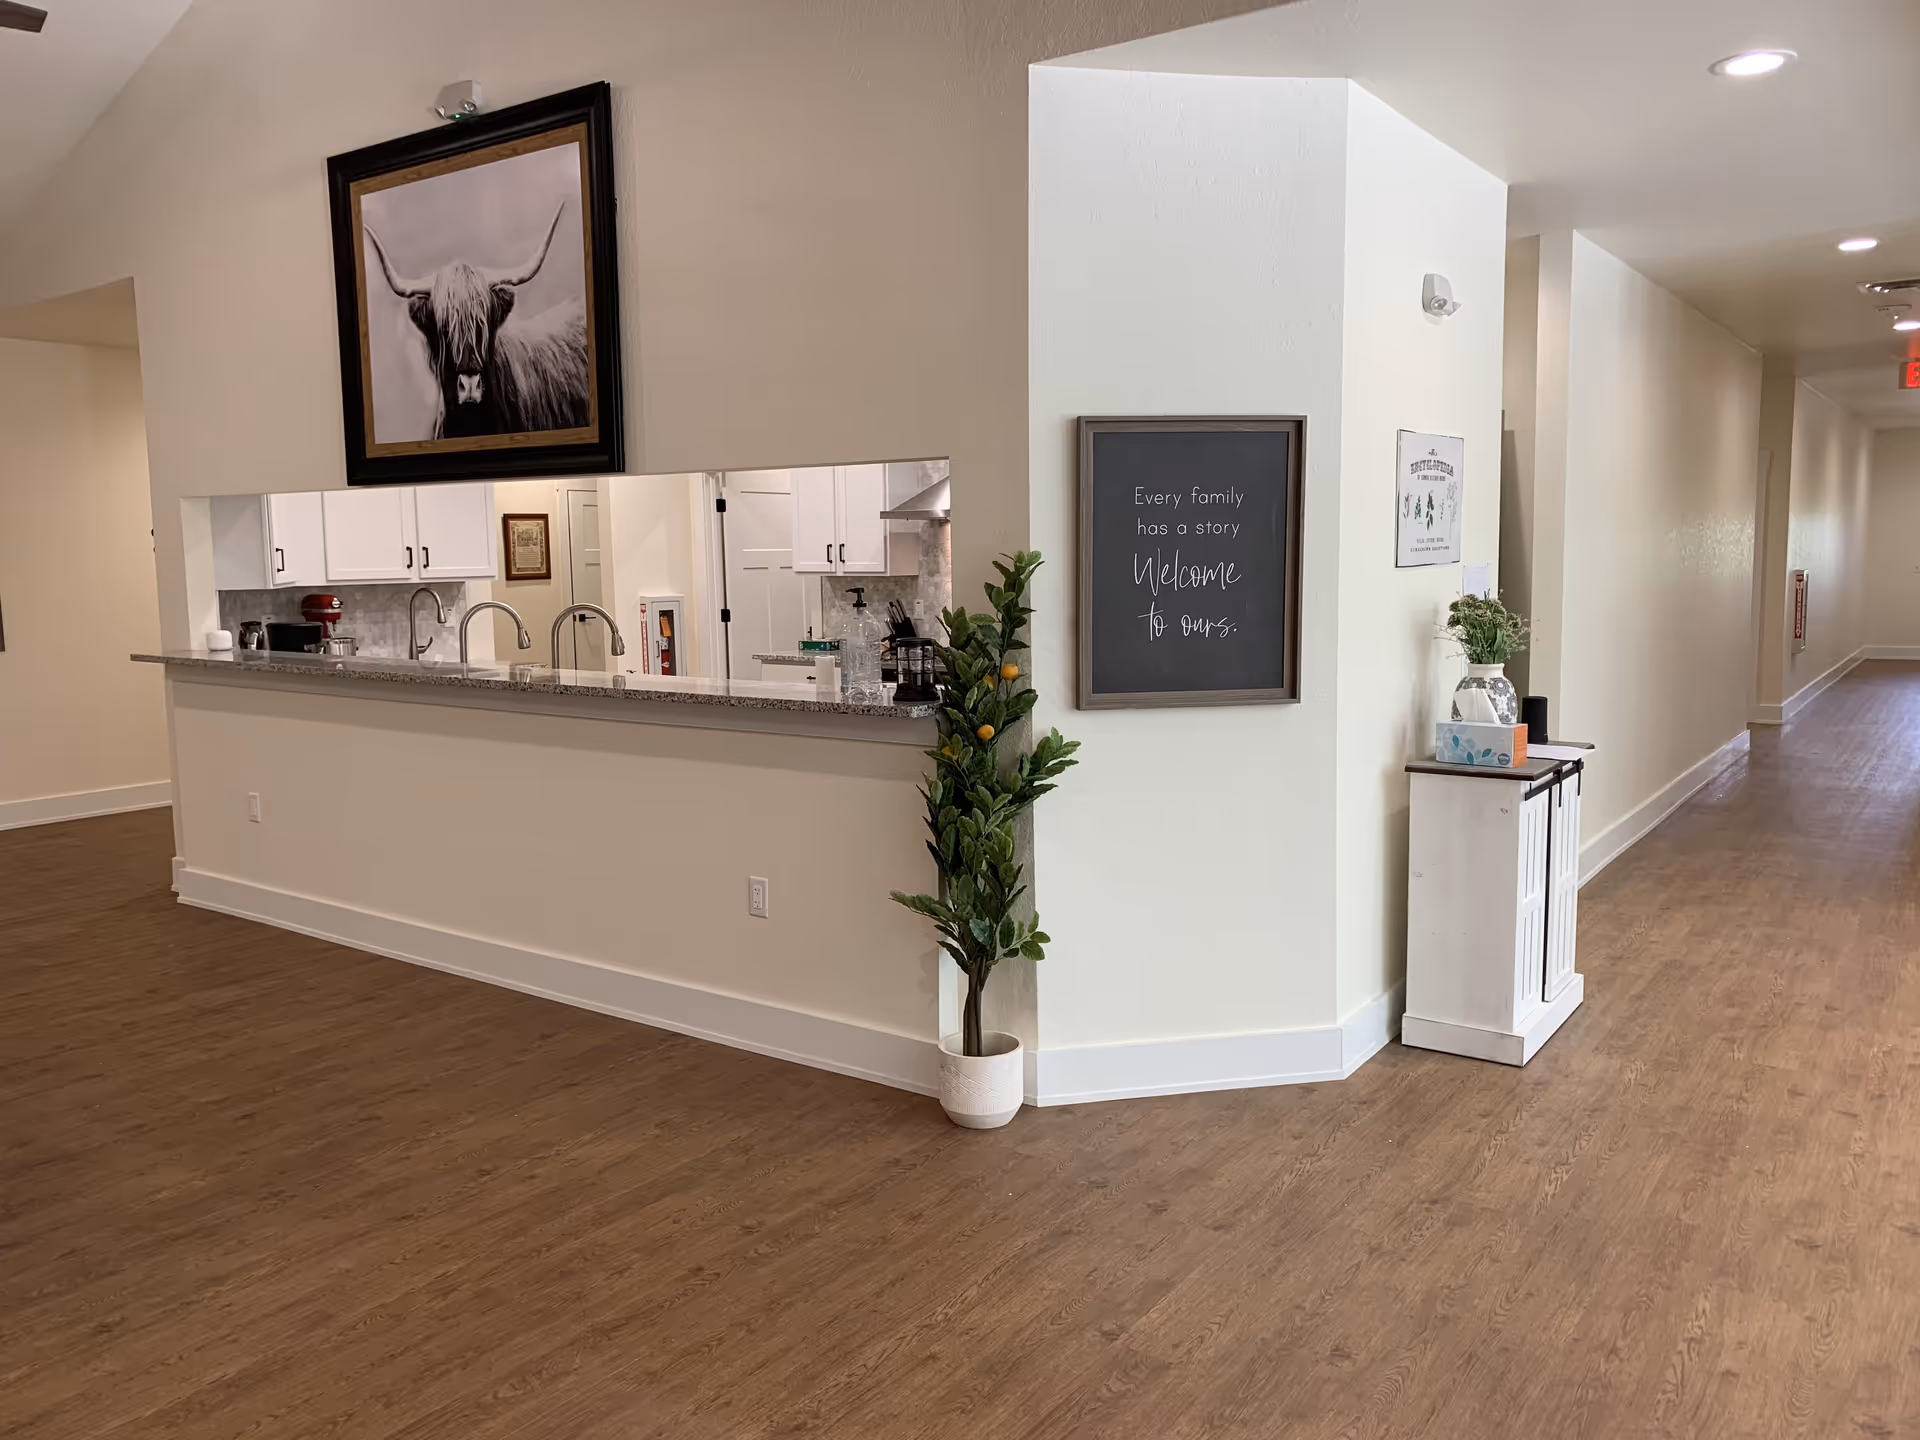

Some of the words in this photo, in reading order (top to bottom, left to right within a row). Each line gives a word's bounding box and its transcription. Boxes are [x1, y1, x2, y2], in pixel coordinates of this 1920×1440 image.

[1134, 486, 1182, 509] Every
[1191, 486, 1244, 508] family
[1137, 517, 1168, 535] has
[1176, 523, 1187, 535] a
[1195, 520, 1241, 539] story
[1133, 548, 1242, 596] Welcome
[1137, 601, 1169, 642] to
[1180, 614, 1238, 638] ours.
